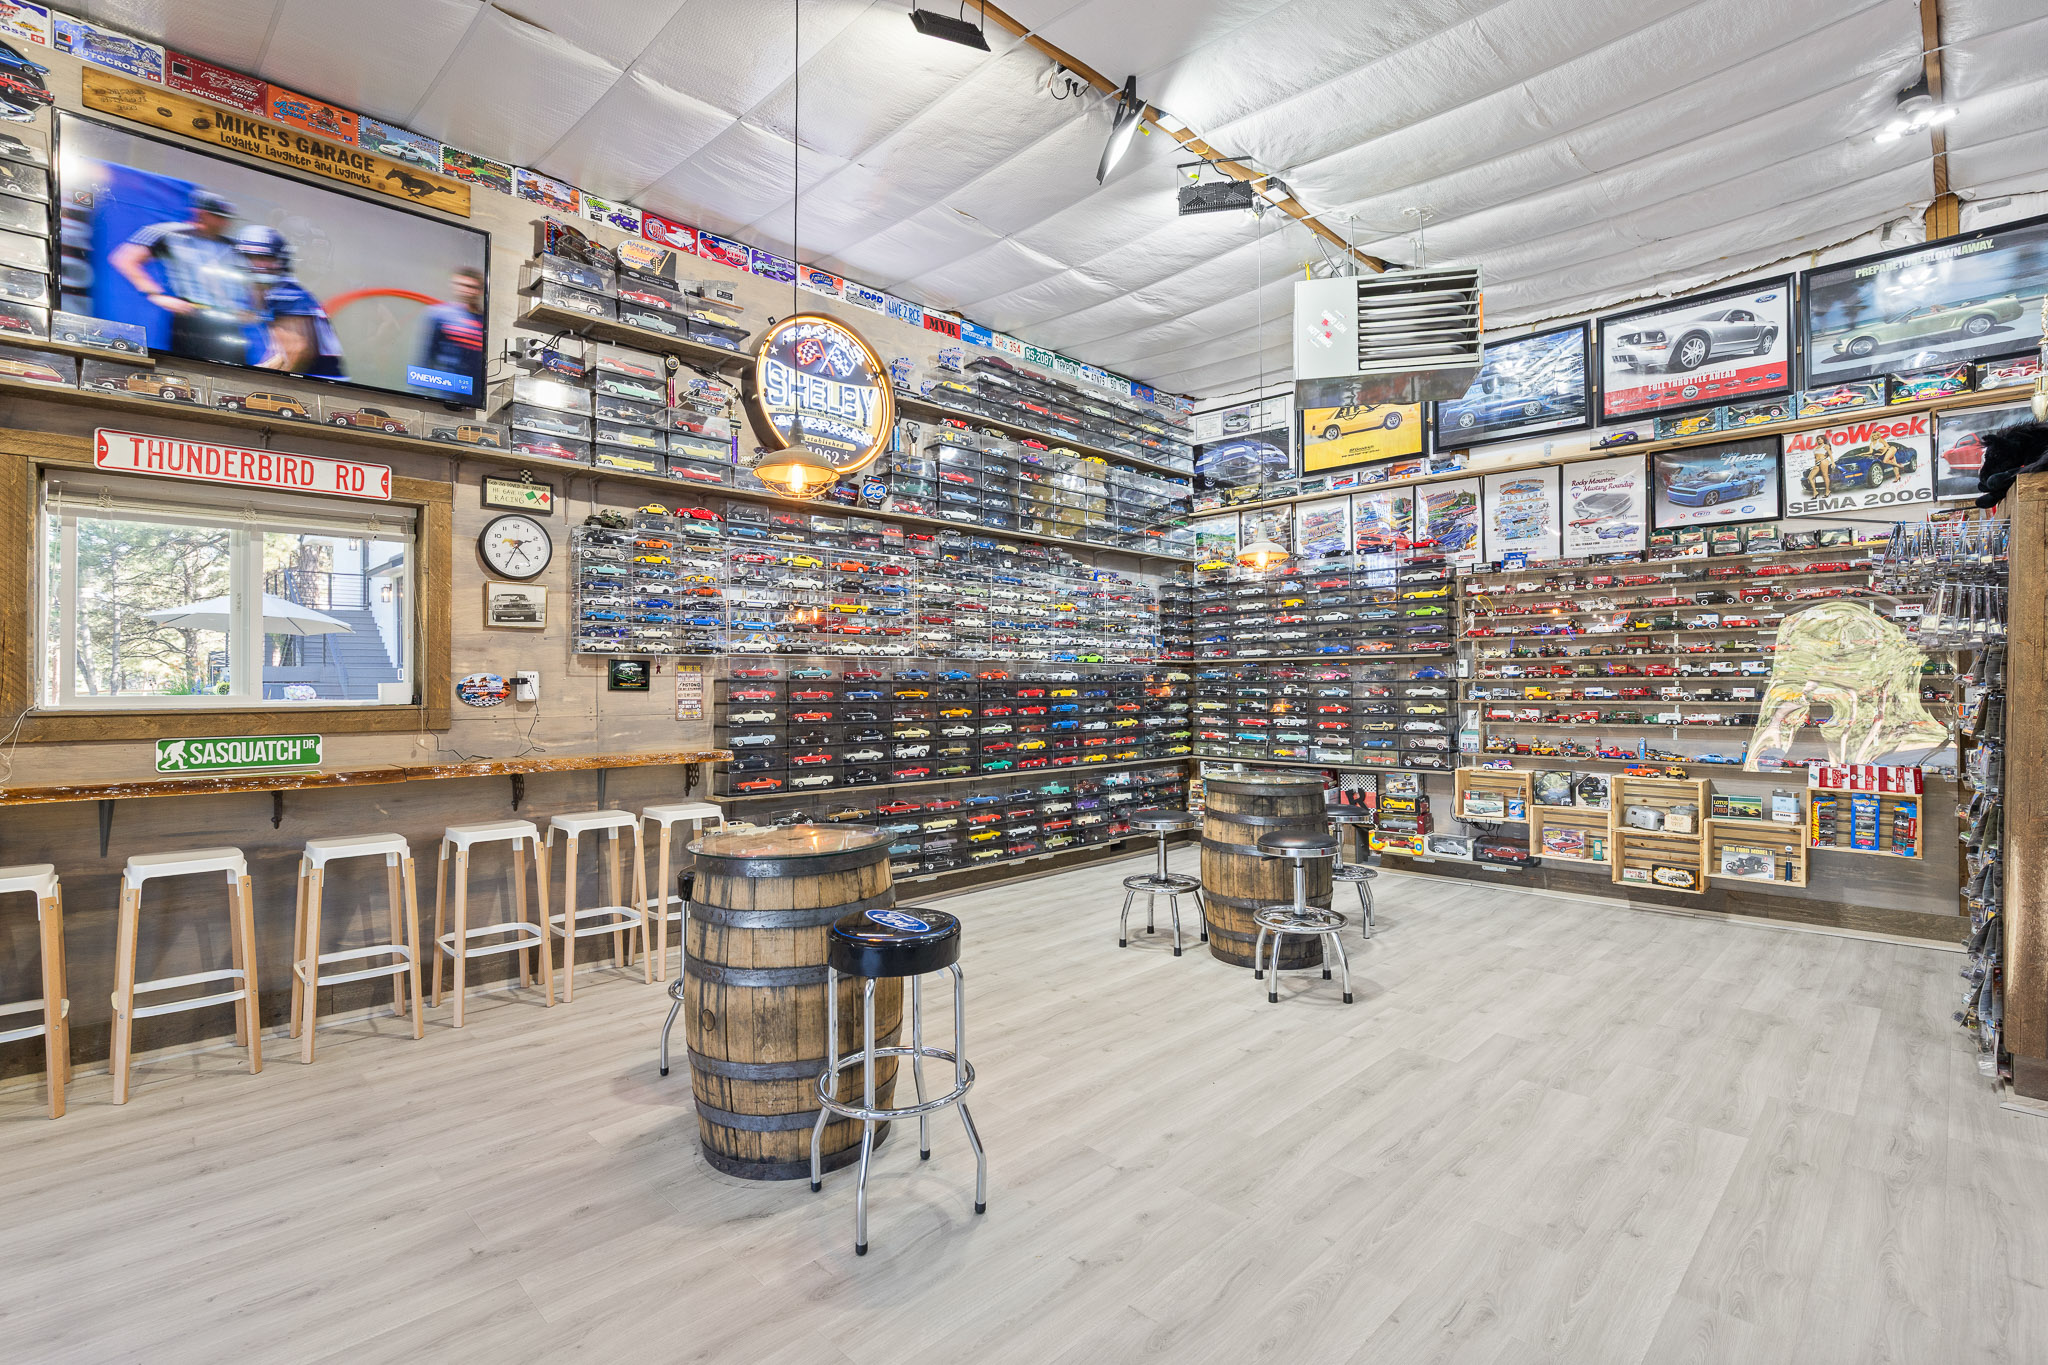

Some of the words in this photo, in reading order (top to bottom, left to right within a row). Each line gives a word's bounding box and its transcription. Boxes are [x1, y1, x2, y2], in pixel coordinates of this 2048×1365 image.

[72, 46, 146, 75] AUTOCROSS
[149, 73, 160, 82] 14
[191, 88, 245, 109] AUTOCROSS
[215, 111, 290, 147] MIKE'S
[296, 137, 375, 173] GARAGE
[266, 144, 312, 167] Laughter
[314, 160, 332, 173] and
[335, 167, 371, 184] Lugnuts
[859, 289, 884, 304] FORD
[888, 300, 902, 317] LIVE
[903, 306, 908, 318] 2
[909, 308, 920, 322] RCE
[929, 318, 957, 337] MVR
[1009, 340, 1021, 354] 354
[410, 371, 442, 385] 9NEWS
[1119, 382, 1128, 394] YRS
[1648, 381, 1666, 392] FULL
[1667, 374, 1708, 389] THROTTLE
[1709, 369, 1737, 381] AHEAD
[765, 358, 879, 427] SHELBY
[804, 434, 845, 449] stablished
[1786, 416, 1930, 454] AutoWeek
[129, 437, 315, 486] THUNDERBIRD
[336, 465, 365, 492] RD
[1571, 479, 1589, 487] Rocky
[1608, 481, 1635, 489] Roundup
[494, 495, 525, 505] RACING
[1788, 496, 1858, 515] SEMA
[1864, 487, 1932, 506] 2006
[189, 739, 301, 764] SASQUATCH
[302, 739, 315, 750] DR
